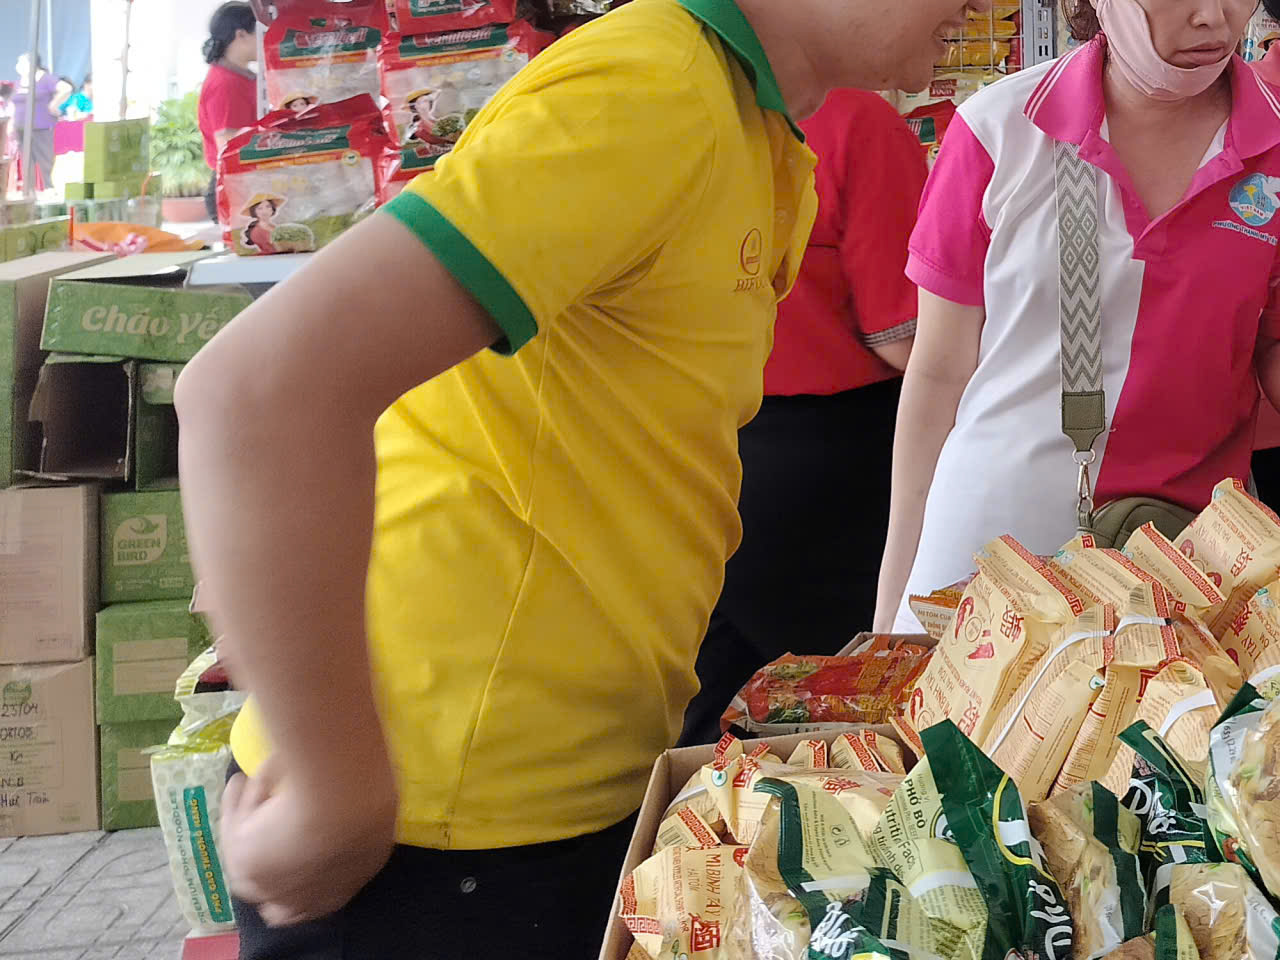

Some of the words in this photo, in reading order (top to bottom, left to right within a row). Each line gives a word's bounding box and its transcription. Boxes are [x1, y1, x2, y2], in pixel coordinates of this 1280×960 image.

[177, 307, 225, 344] Yế
[117, 538, 162, 550] GREEN
[117, 551, 149, 562] BIRD
[904, 778, 923, 807] PHỞ
[912, 809, 928, 829] BÒ
